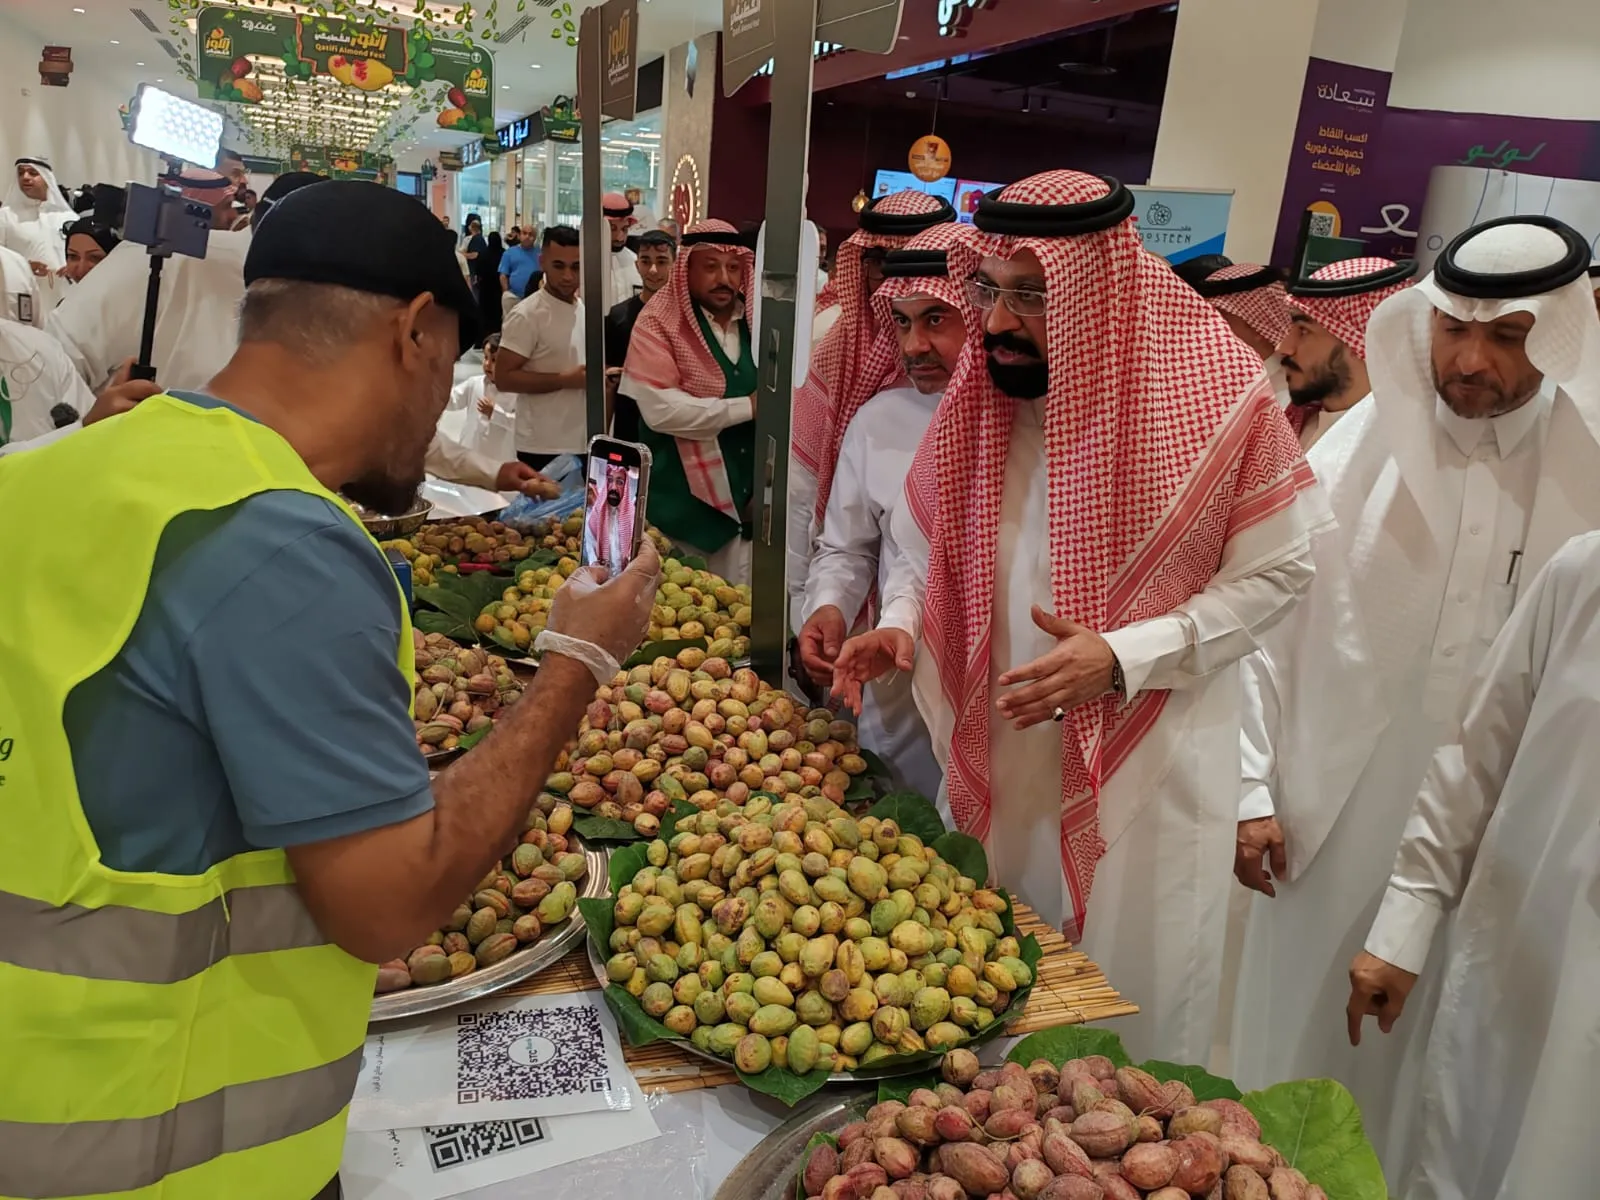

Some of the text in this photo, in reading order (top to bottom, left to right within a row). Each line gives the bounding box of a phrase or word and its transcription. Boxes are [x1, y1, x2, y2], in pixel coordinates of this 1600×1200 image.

[315, 43, 386, 59] Qatifi Almond Fest
[1317, 83, 1375, 107] سعادة
[1318, 126, 1343, 139] النقاط
[1304, 141, 1364, 160] خصومات فورية
[1456, 139, 1547, 168] لولو
[528, 1049, 538, 1063] STC
